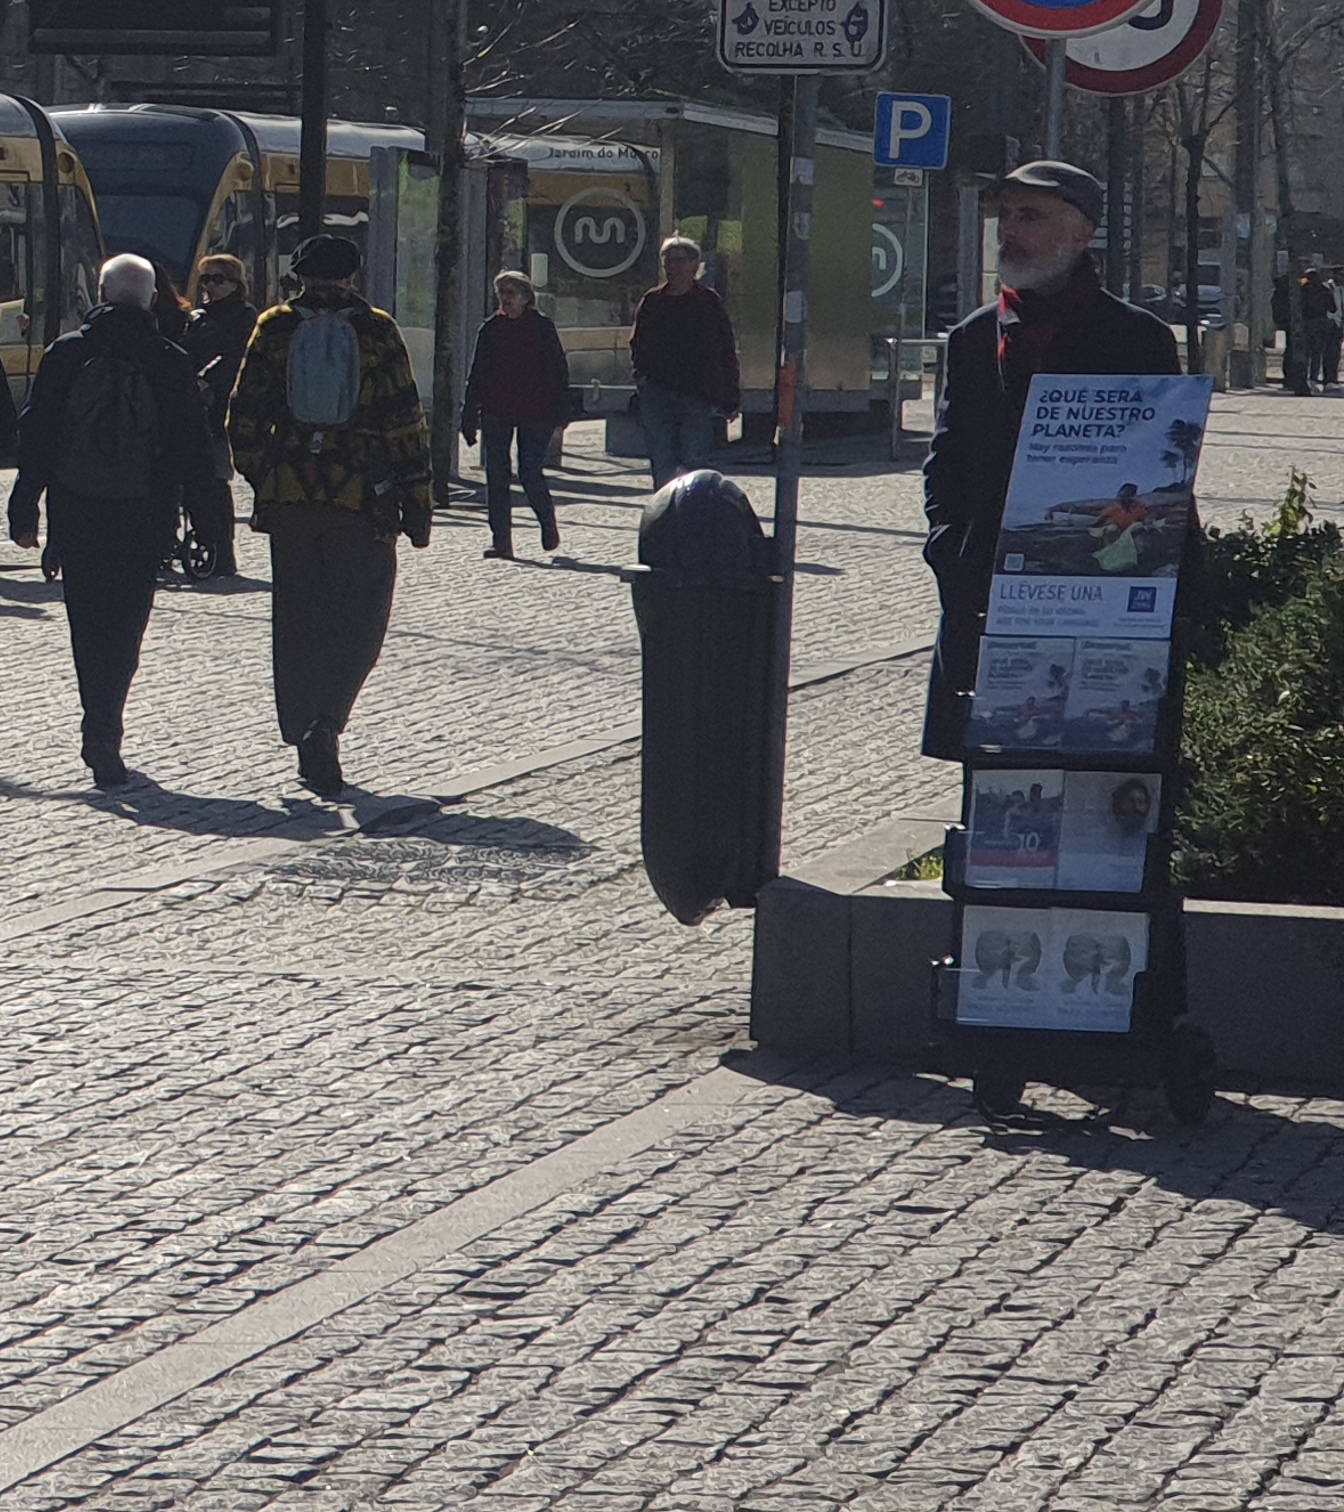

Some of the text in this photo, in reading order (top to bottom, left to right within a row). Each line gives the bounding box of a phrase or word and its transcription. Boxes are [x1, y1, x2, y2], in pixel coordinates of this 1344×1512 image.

[735, 41, 804, 58] RECOLHA
[888, 100, 932, 159] P
[597, 147, 614, 158] do
[1036, 407, 1156, 421] DE NUESTRO
[1032, 423, 1126, 438] PLANETA?
[1071, 585, 1103, 601] UNA
